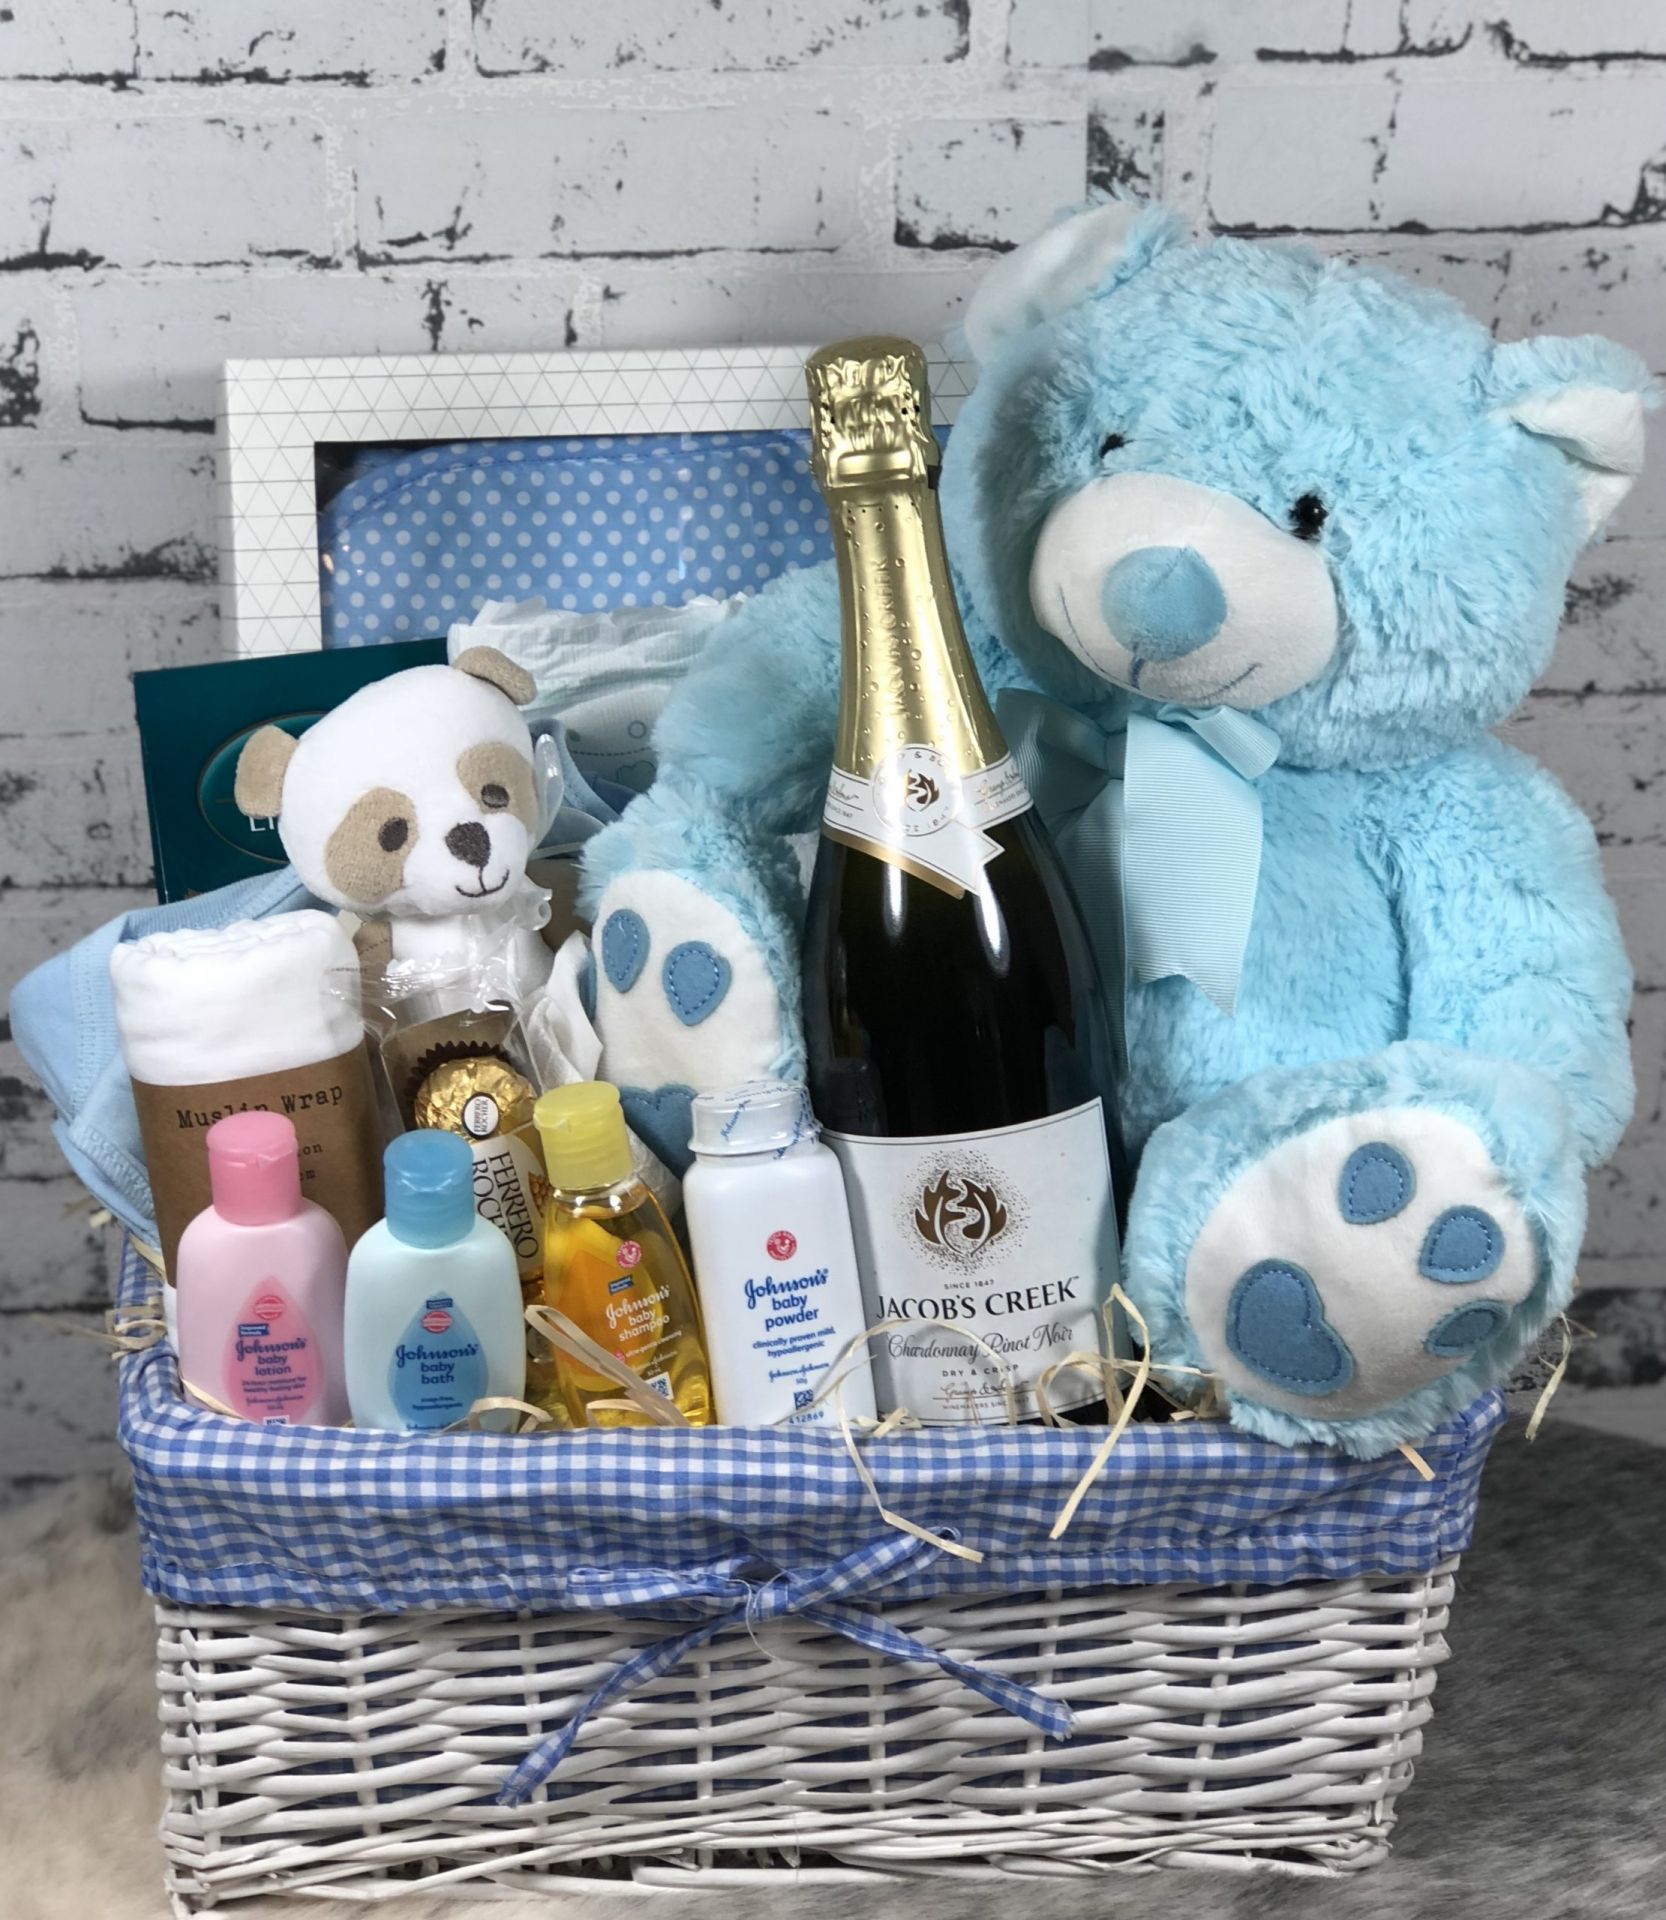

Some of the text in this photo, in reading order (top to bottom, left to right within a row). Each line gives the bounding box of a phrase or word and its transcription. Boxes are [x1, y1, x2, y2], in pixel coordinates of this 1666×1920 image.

[281, 1085, 343, 1114] Wrap
[489, 1151, 539, 1259] FERRERO
[744, 1268, 827, 1310] Johnson's
[944, 1279, 994, 1290] SINCE 1847
[605, 1285, 670, 1329] Johnson's
[772, 1294, 807, 1310] baby
[876, 1294, 976, 1320] JACOB'S
[628, 1308, 656, 1326] baby
[765, 1309, 819, 1332] powder
[618, 1315, 670, 1342] shampoo
[235, 1337, 307, 1362] Johnson's
[752, 1337, 787, 1349] clinically
[789, 1332, 816, 1344] proven
[767, 1341, 825, 1358] hypoallergenic
[888, 1322, 1073, 1364] Chardonnay Pinot Noir
[257, 1355, 288, 1366] baby
[396, 1344, 478, 1368] Johnson's
[255, 1366, 292, 1376] lotion
[420, 1361, 455, 1373] baby
[421, 1372, 455, 1384] bath
[789, 1411, 824, 1424] 412869
